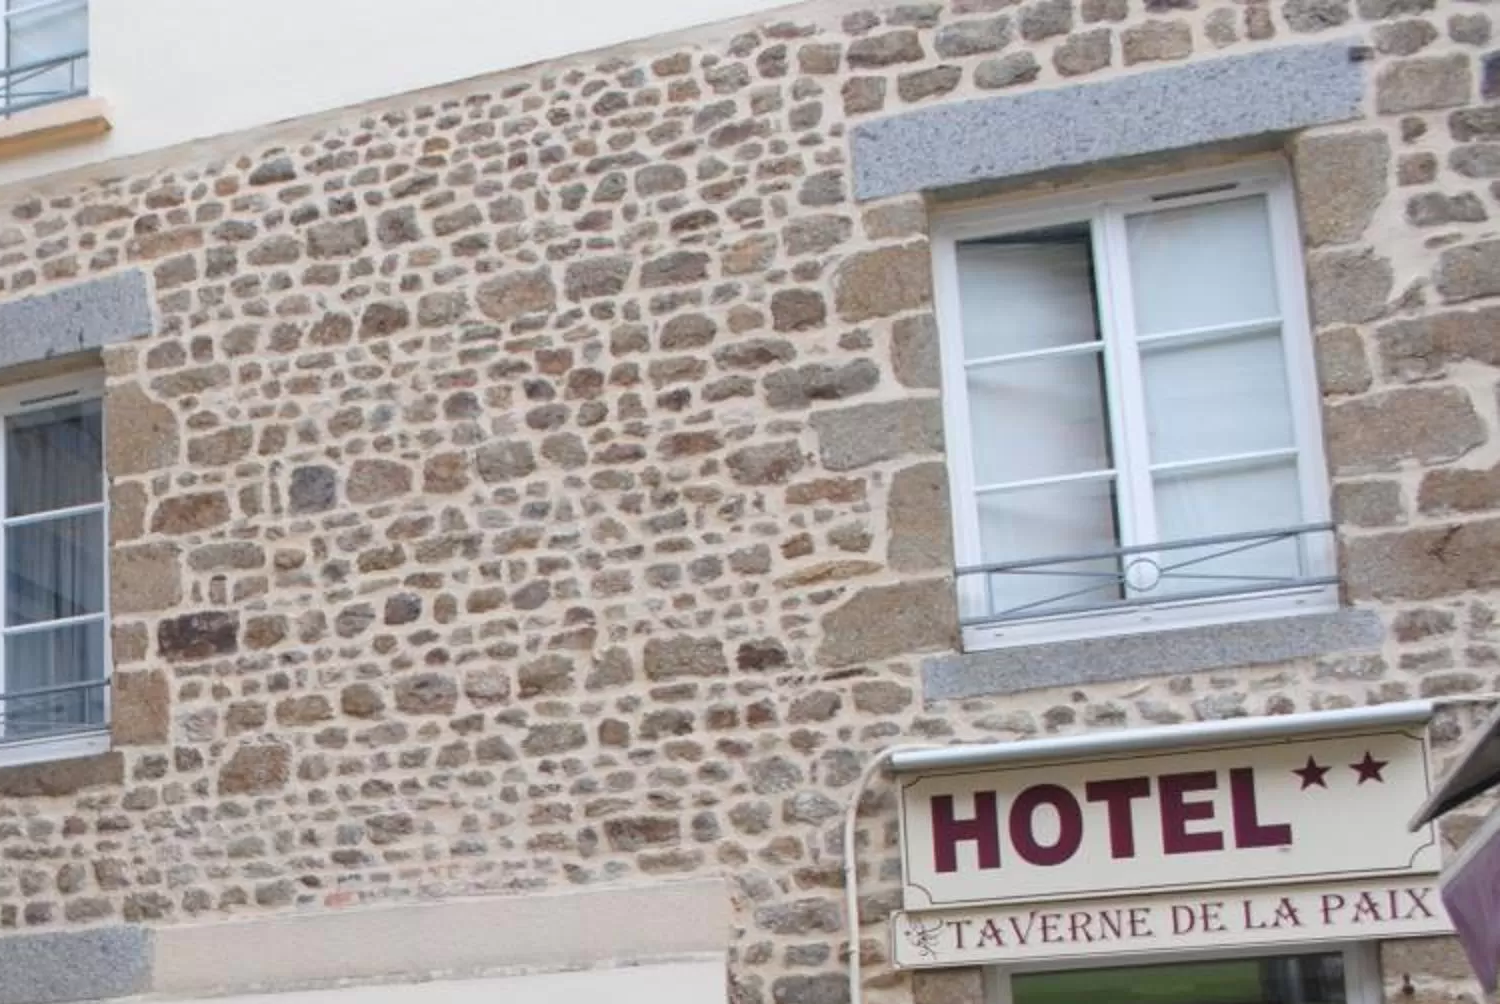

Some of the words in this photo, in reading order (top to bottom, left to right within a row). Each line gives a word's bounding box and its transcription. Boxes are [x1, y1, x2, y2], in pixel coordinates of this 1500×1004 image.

[931, 767, 1293, 873] HOTEL
[946, 905, 1154, 950] TAVERNE
[1170, 901, 1226, 936] DE
[1243, 897, 1301, 929] LA
[1320, 887, 1436, 925] PAIX
